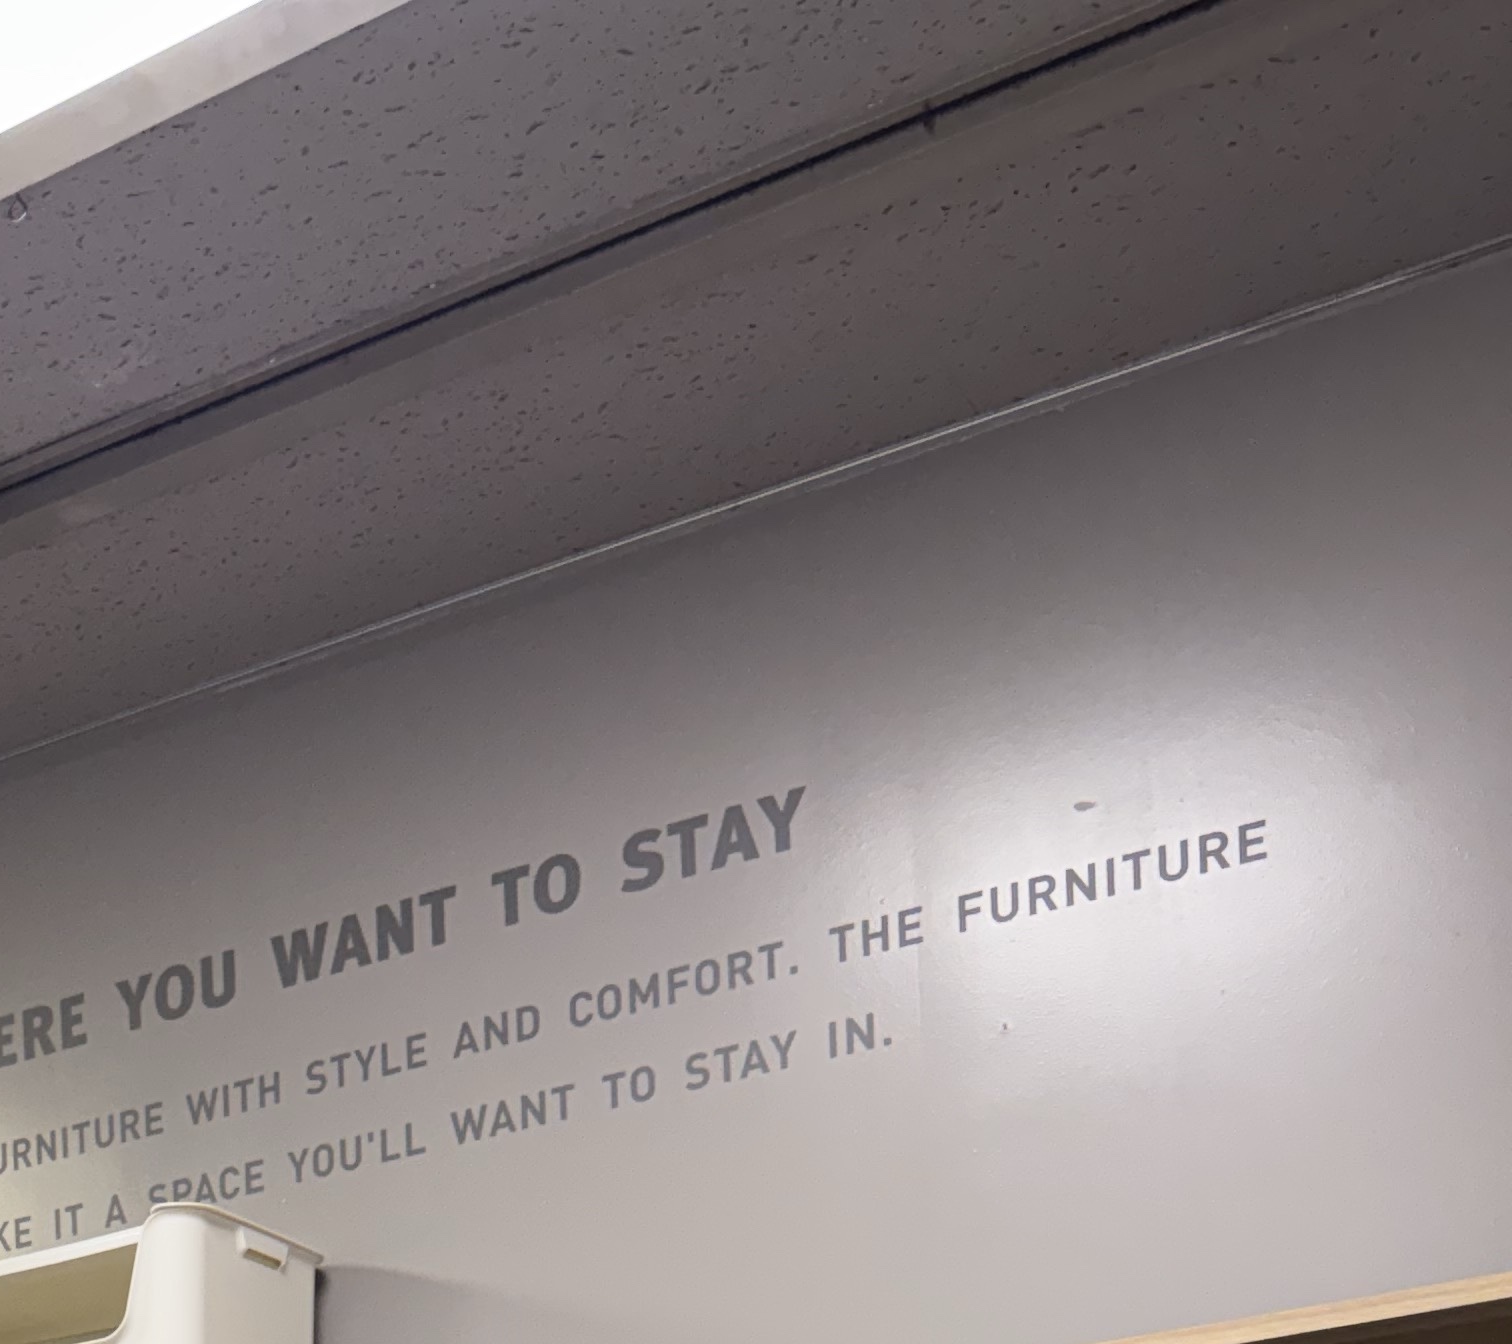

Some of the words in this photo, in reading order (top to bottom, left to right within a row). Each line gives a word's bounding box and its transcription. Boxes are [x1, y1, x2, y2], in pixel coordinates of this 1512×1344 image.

[114, 949, 236, 1031] YOU
[270, 885, 457, 988] WANT
[491, 853, 582, 926] TO
[620, 786, 806, 893] STAY
[185, 1071, 281, 1125] WITH
[306, 1032, 428, 1095] STYLE
[453, 1005, 541, 1059] AND
[569, 941, 798, 1027] COMFORT.
[829, 905, 924, 963] THE
[957, 819, 1268, 933] FURNITURE
[54, 1203, 83, 1240] IT
[105, 1194, 128, 1228] A
[148, 1159, 265, 1204] SPACE
[288, 1122, 427, 1183] YOU'LL
[450, 1083, 575, 1145] WANT
[602, 1066, 656, 1110] TO
[685, 1030, 797, 1091] STAY
[828, 1013, 893, 1059] IN.
